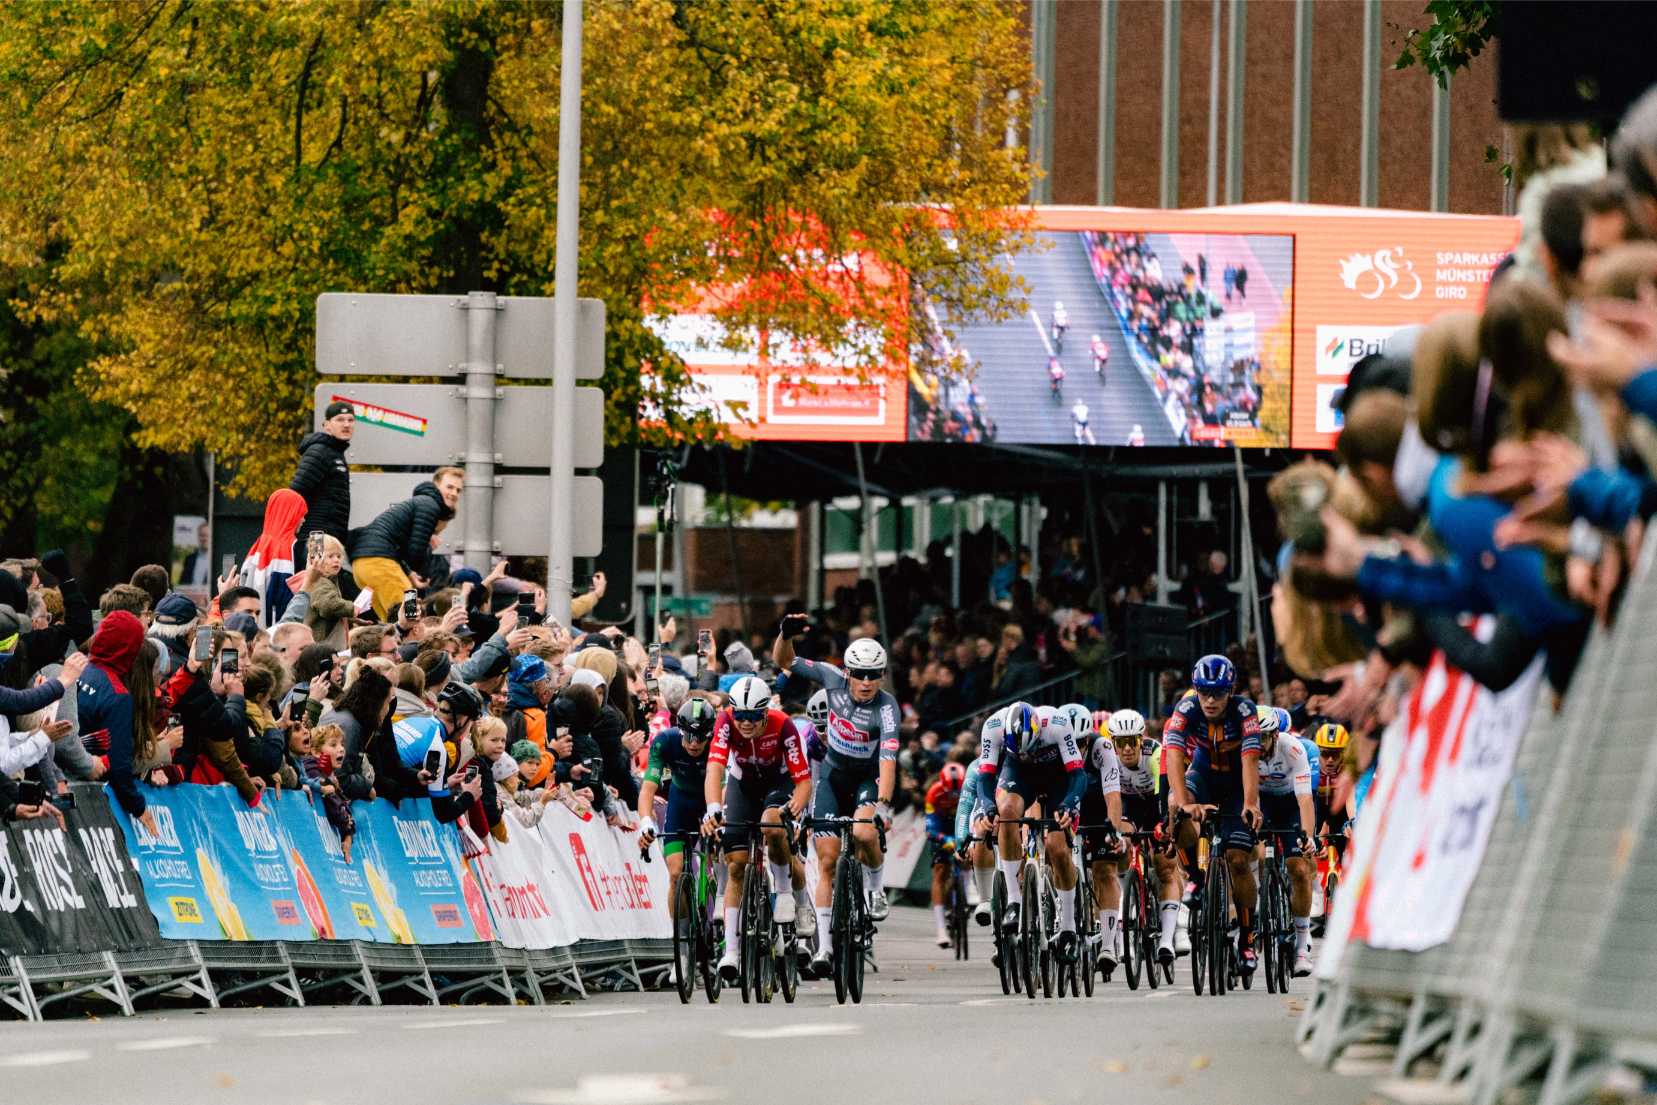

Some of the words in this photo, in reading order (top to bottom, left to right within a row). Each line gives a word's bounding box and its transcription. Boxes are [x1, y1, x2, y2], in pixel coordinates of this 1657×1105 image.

[1436, 287, 1467, 299] GIRO
[784, 735, 800, 765] lotto
[1063, 733, 1078, 756] BOSS
